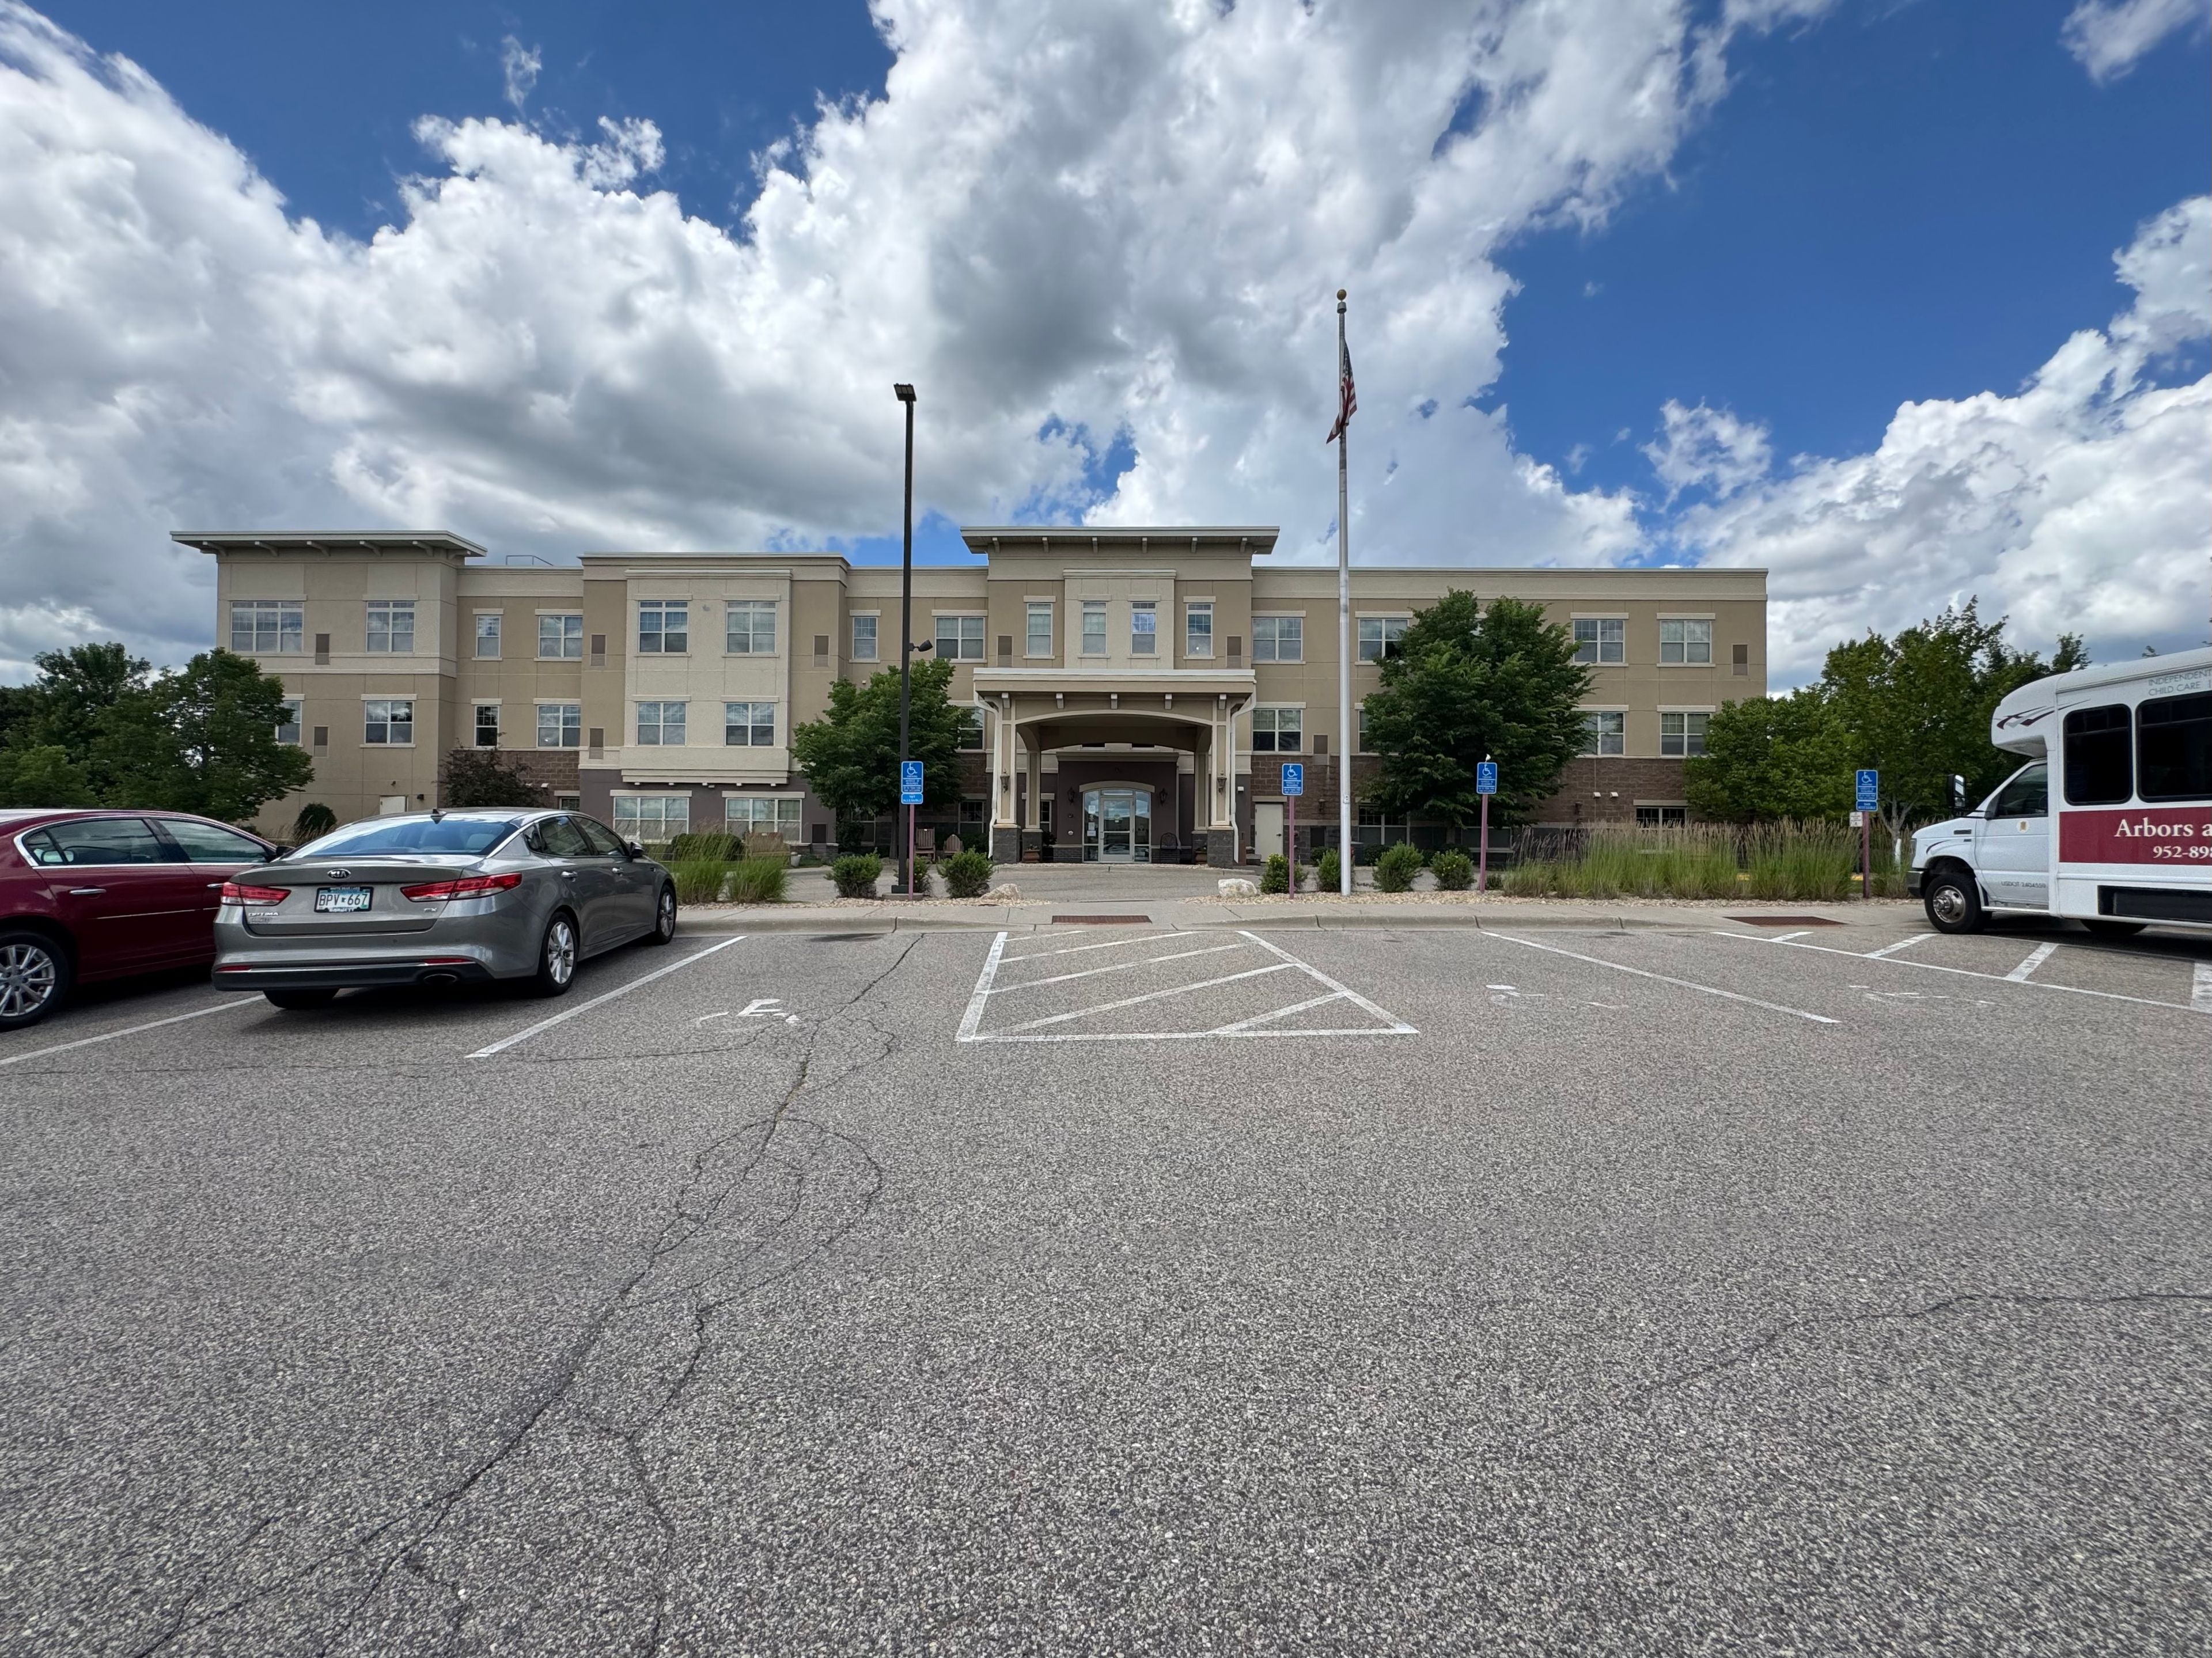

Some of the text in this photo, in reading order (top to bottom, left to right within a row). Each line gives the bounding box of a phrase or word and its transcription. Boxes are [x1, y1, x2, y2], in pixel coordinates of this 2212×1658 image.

[2148, 669, 2212, 686] INDEPENDENT
[2148, 681, 2201, 696] CHILD CARE
[2113, 817, 2194, 837] Arbors
[2152, 845, 2212, 859] 952-89
[319, 893, 368, 906] BPV 667
